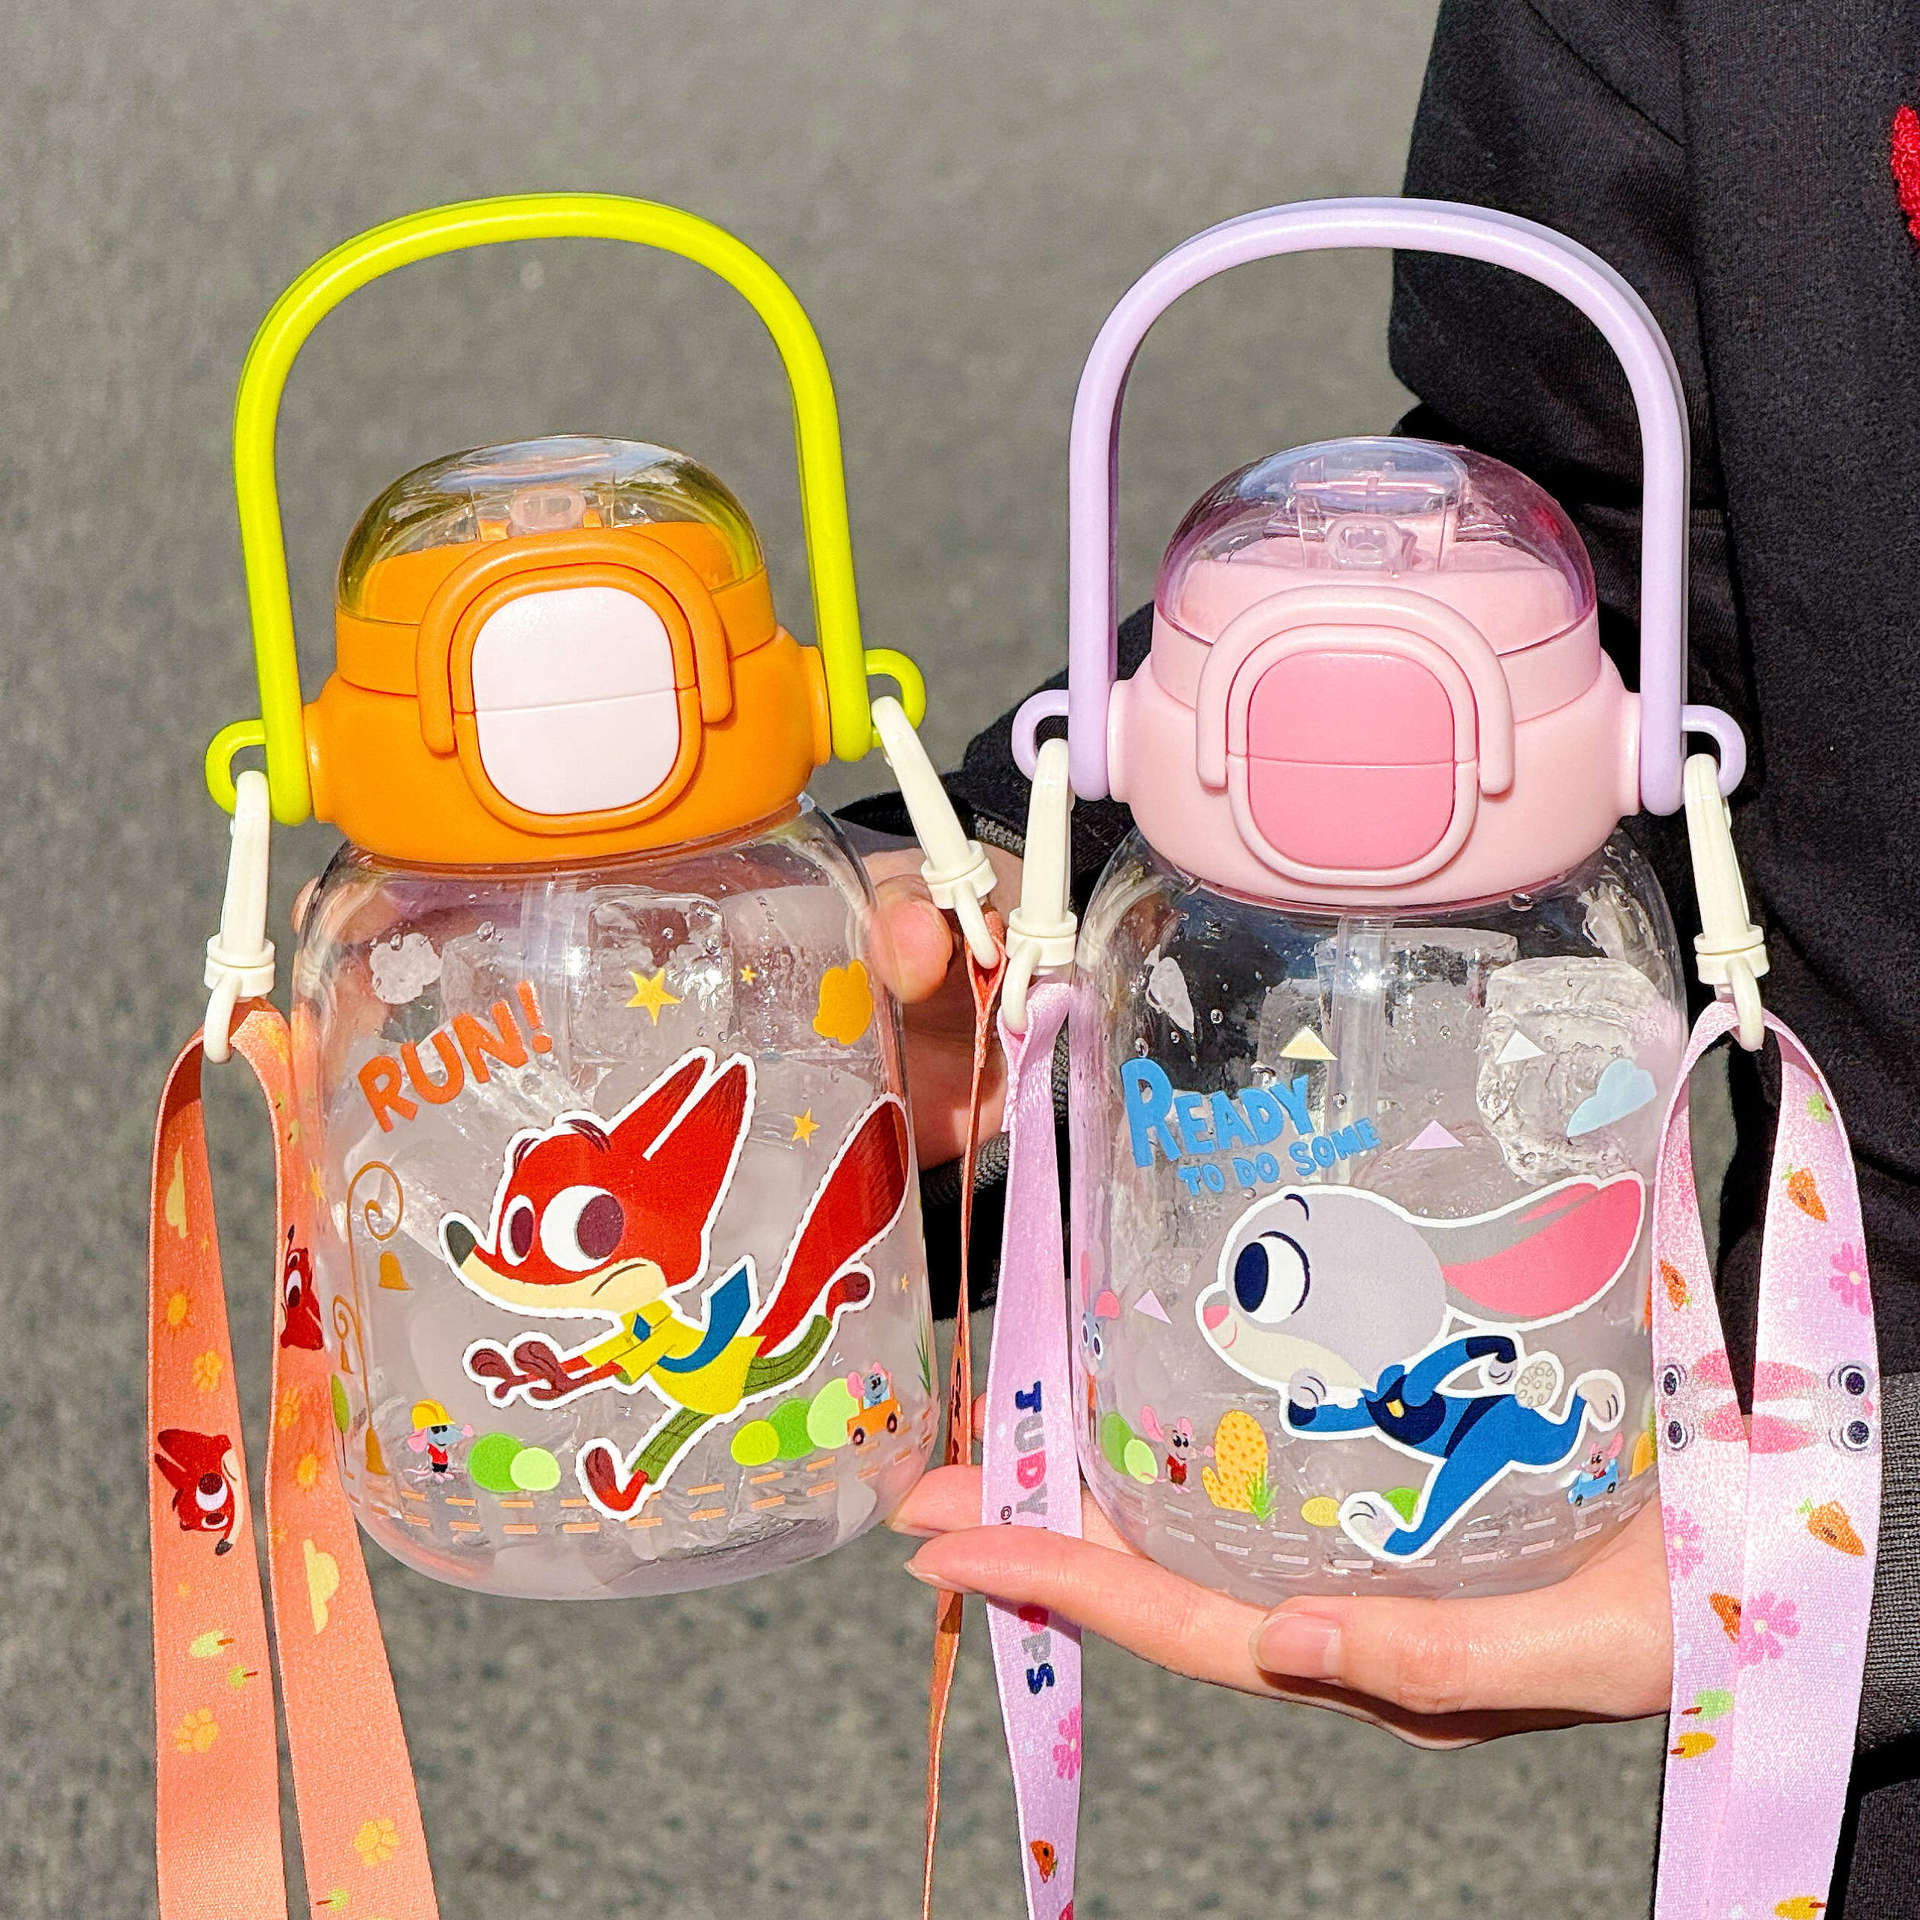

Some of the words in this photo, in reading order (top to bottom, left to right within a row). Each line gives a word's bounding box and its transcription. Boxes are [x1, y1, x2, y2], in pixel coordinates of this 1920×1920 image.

[357, 979, 553, 1133] RUN!
[1120, 1057, 1314, 1167] READY
[1176, 1163, 1225, 1196] TO
[1232, 1152, 1280, 1188] DO
[1288, 1117, 1381, 1177] SOME
[1014, 1380, 1048, 1516] JUDY
